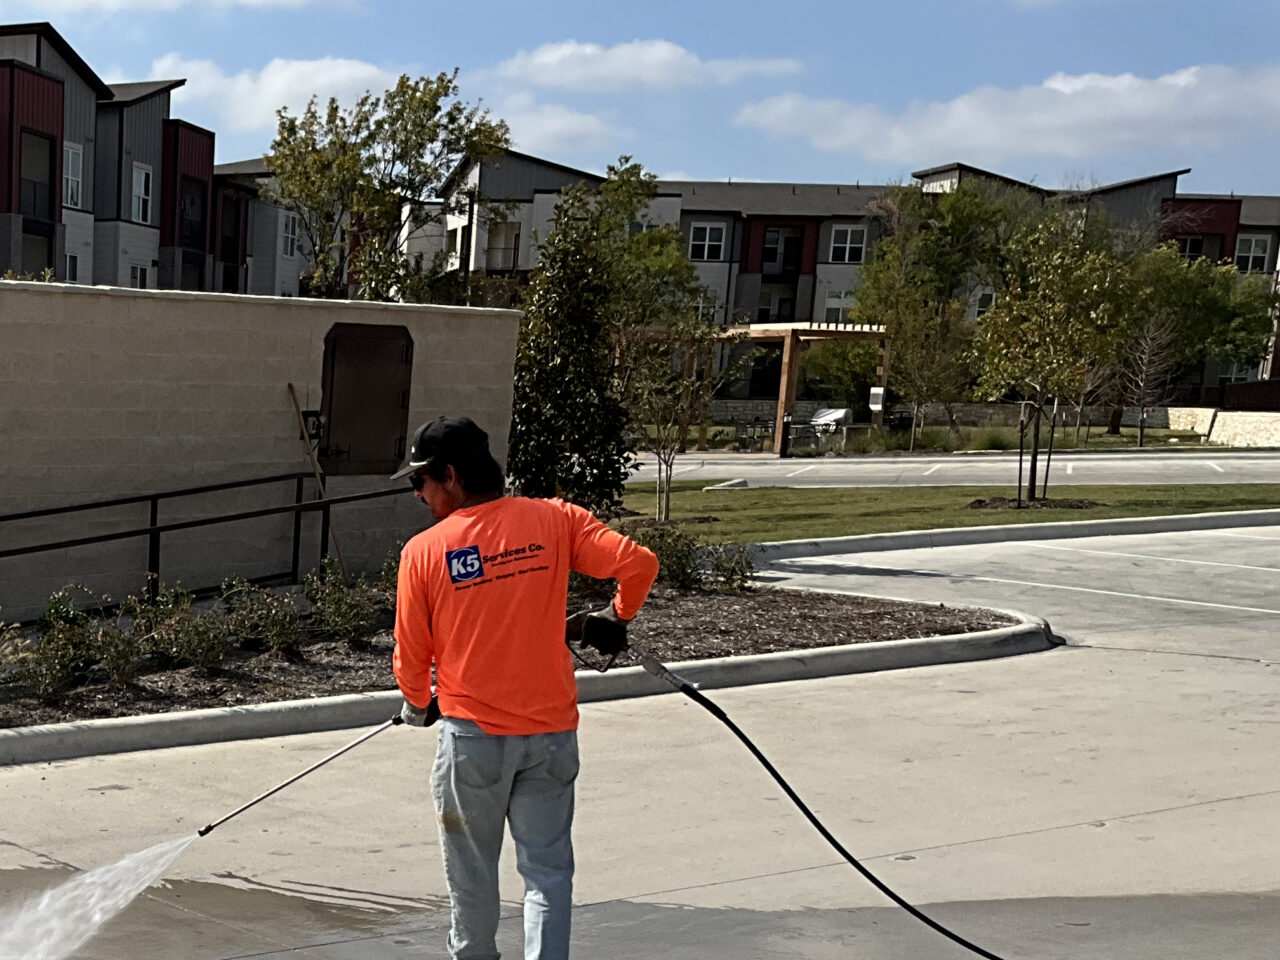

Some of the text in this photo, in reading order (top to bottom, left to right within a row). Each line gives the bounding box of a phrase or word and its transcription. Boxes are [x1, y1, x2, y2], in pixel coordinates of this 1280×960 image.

[451, 554, 480, 577] K5
[482, 547, 526, 564] Services
[528, 543, 545, 553] Co.
